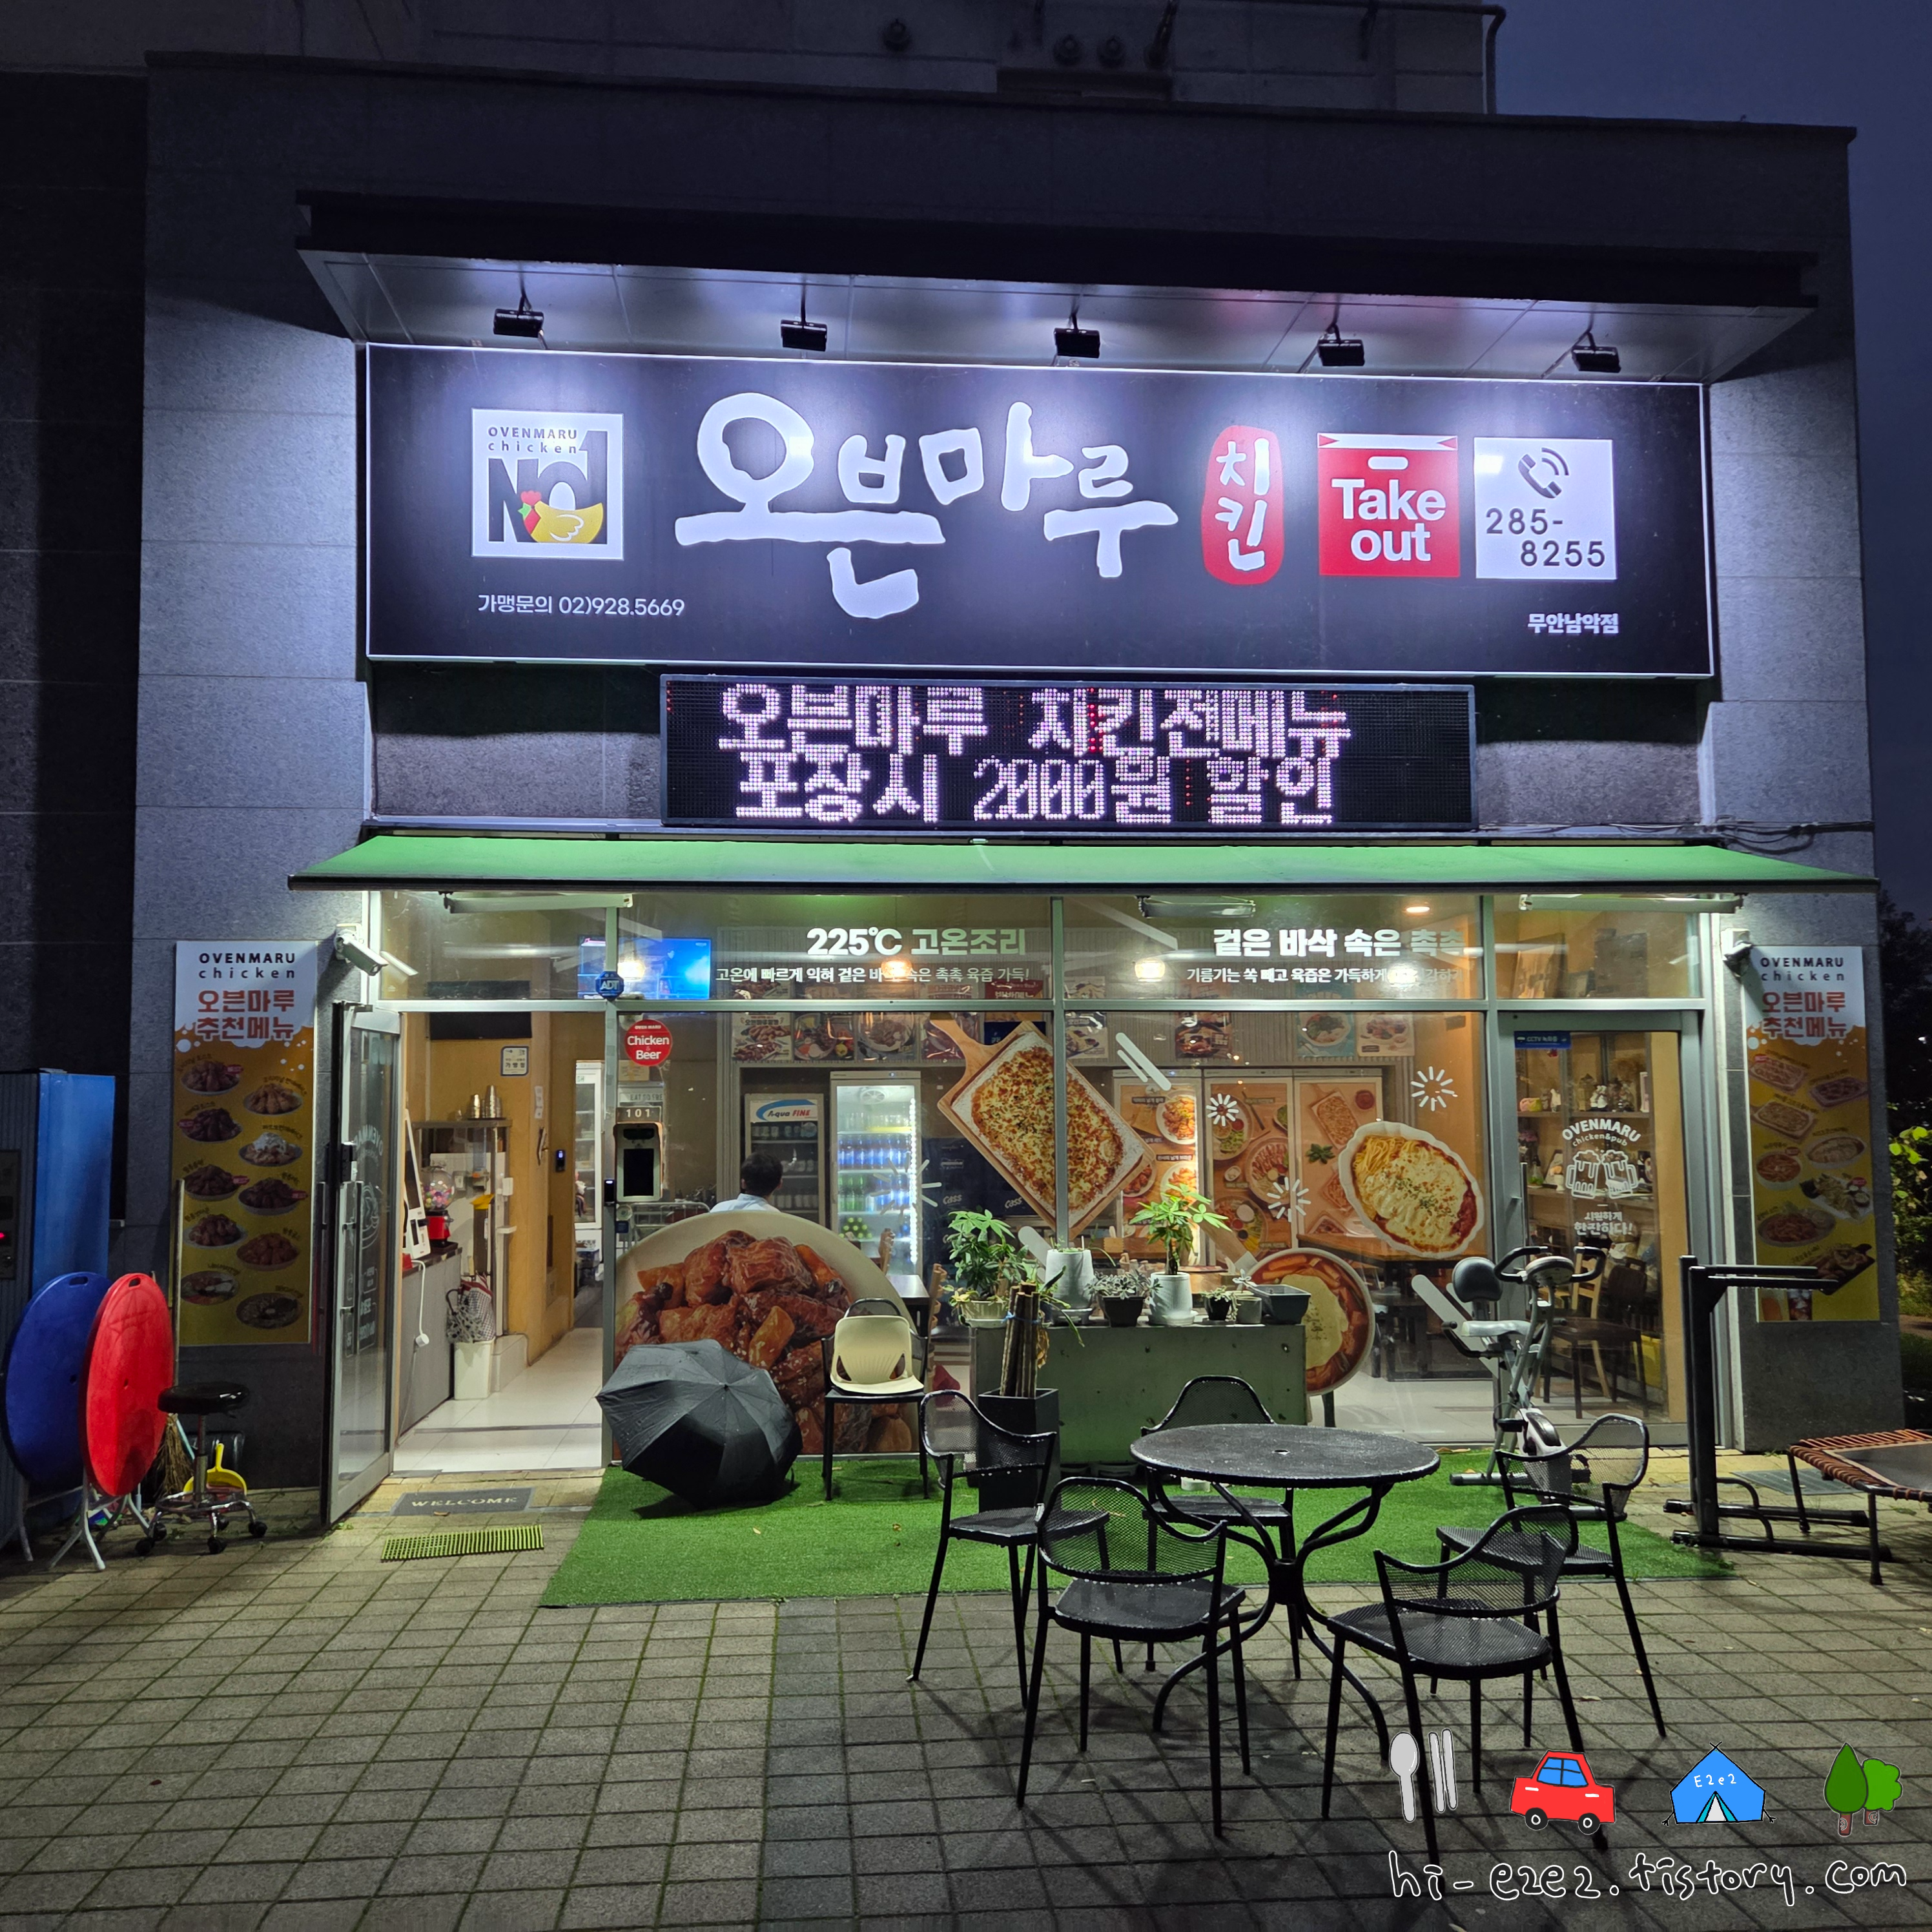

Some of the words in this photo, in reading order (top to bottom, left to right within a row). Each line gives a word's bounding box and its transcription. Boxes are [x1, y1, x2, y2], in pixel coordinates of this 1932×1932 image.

[488, 426, 577, 440] OVENMARU
[488, 440, 577, 453] chicken
[675, 393, 1178, 619] 오븐마루
[1215, 438, 1270, 571] 치킨
[1331, 478, 1446, 522] Take
[1486, 508, 1563, 535] 285-
[1350, 522, 1432, 561] out
[1520, 540, 1606, 568] 8255
[478, 595, 553, 613] 가맹문의
[559, 595, 685, 617] 02)928.5669
[1527, 612, 1619, 634] 무안남악점
[718, 683, 989, 756] 오븐마루
[735, 750, 938, 823] 포장시
[1206, 756, 1333, 825] 할인
[911, 927, 1025, 956] 고온조리
[1213, 929, 1271, 957] 겉은
[1279, 929, 1338, 957] 바삭
[1344, 929, 1401, 957] 속은
[1410, 929, 1465, 957] 촉촉
[199, 952, 296, 964] OVENMARU
[1760, 957, 1844, 968] OVENMARU
[199, 967, 295, 979] chicken
[715, 967, 757, 982] 고온에
[761, 967, 803, 982] 빠르게
[807, 967, 834, 982] 익혀
[838, 967, 867, 982] 겉은
[936, 968, 963, 982] 촉촉
[967, 968, 994, 982] 육즙
[998, 967, 1029, 981] 가득!
[1187, 968, 1241, 983] 기름기는
[1243, 968, 1258, 983] 쏙
[1260, 968, 1289, 983] 빼고
[1291, 968, 1332, 983] 육즙은
[1334, 968, 1387, 983] 가득하게
[1761, 971, 1845, 981] chicken
[600, 980, 619, 991] ADT
[198, 989, 295, 1013] 오븐마루
[1762, 991, 1846, 1013] 오븐마루
[197, 1016, 294, 1040] 추천메뉴
[1762, 1016, 1847, 1039] 추천메뉴
[627, 1034, 670, 1046] Chicken
[636, 1050, 662, 1060] Beer
[626, 1108, 650, 1118] 101
[1561, 1118, 1642, 1142] OVENMARU
[411, 1496, 517, 1507] WELCOME
